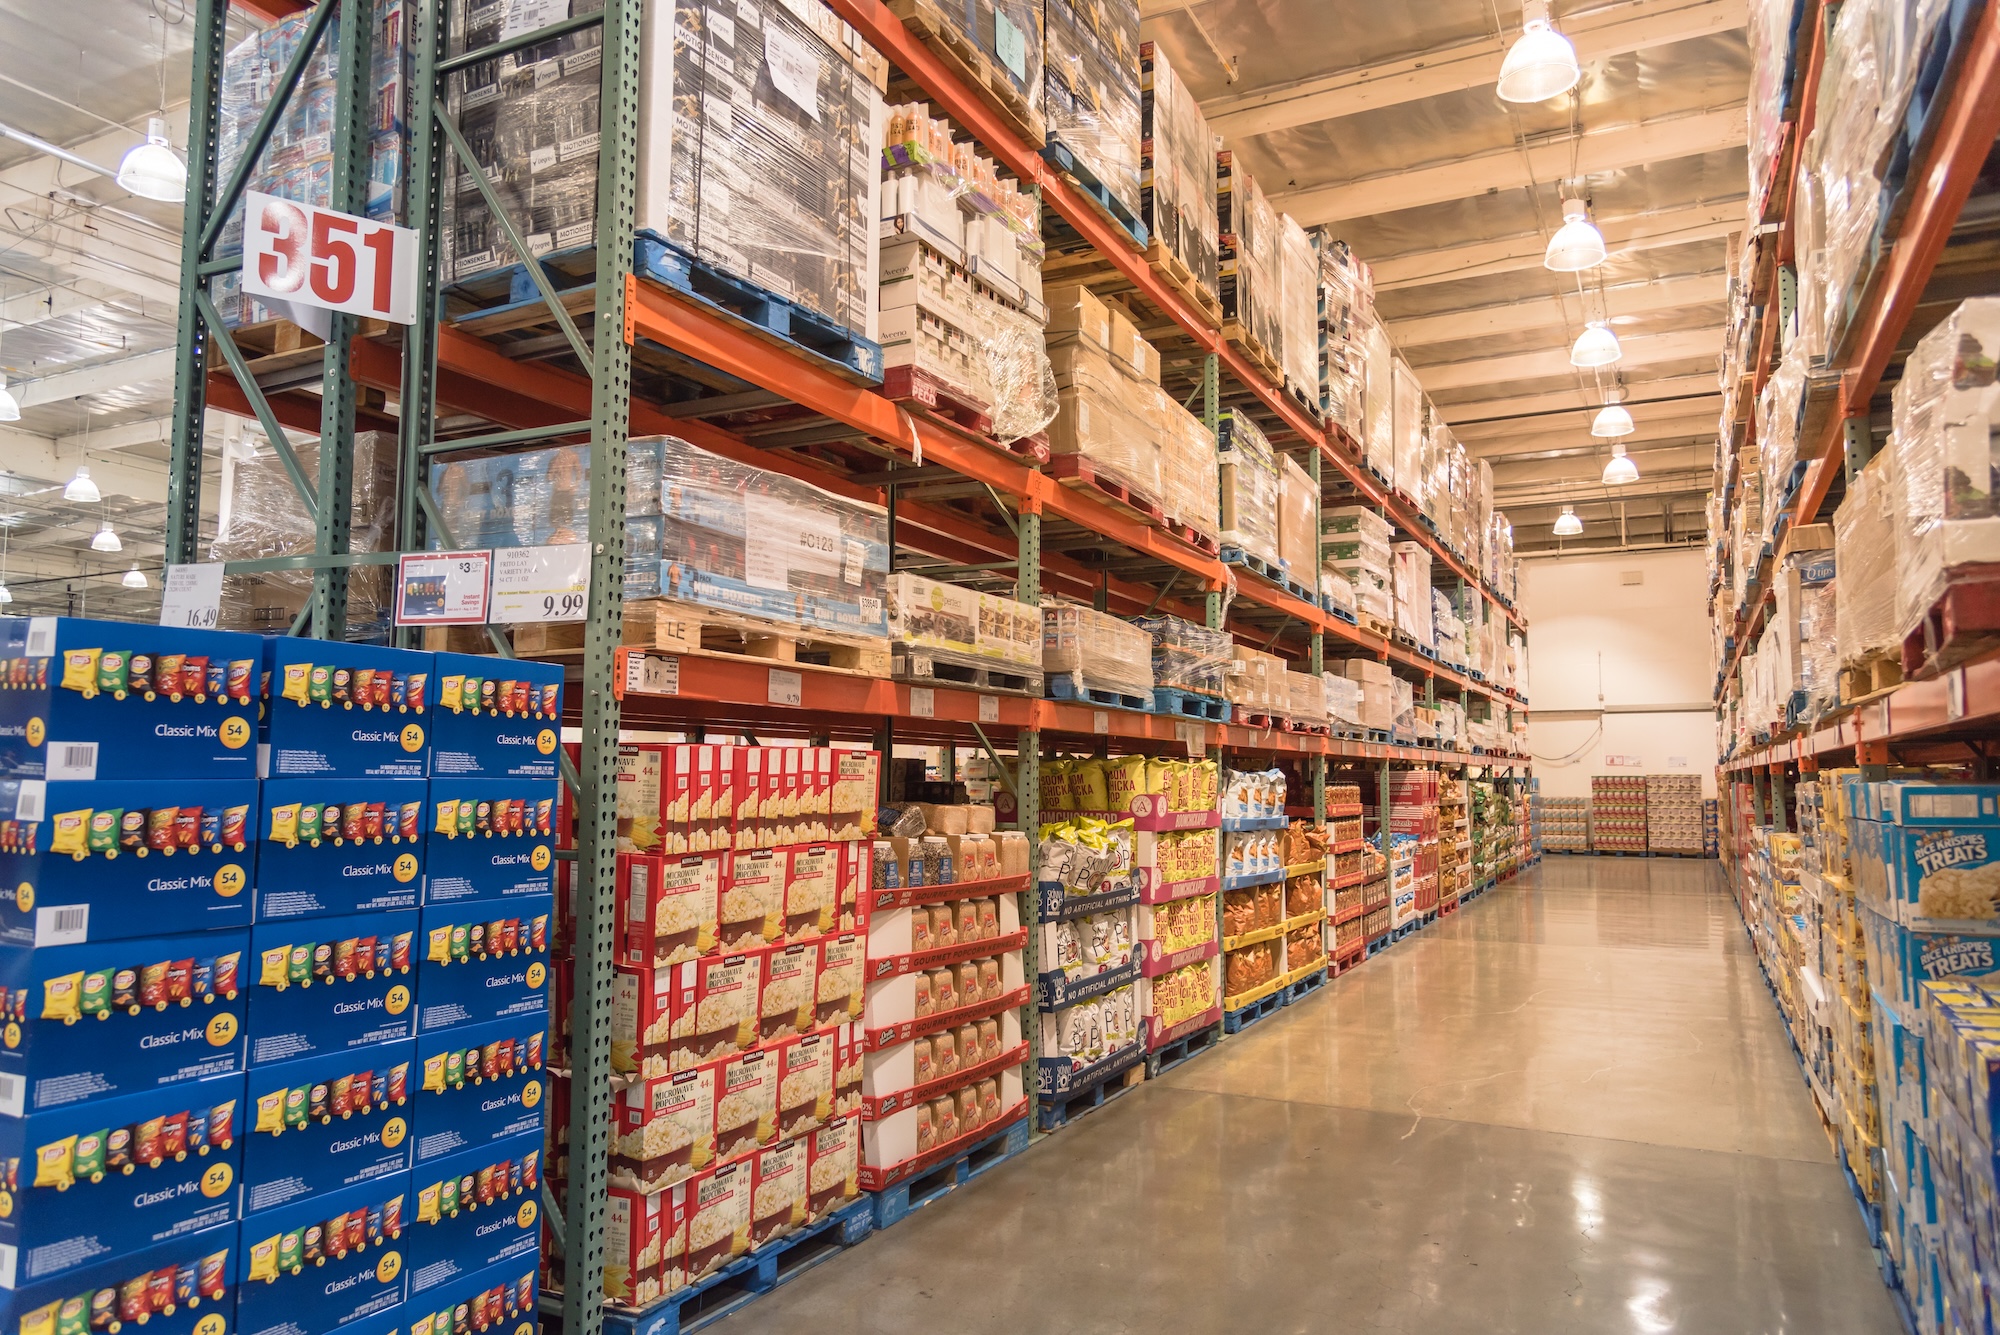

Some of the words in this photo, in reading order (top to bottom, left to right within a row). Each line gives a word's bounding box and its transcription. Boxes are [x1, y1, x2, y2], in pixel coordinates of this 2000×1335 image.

[712, 16, 729, 35] Degree
[678, 29, 728, 66] MOTIOSENSE
[567, 48, 601, 66] MOTIONSEN
[541, 69, 558, 81] Degree
[534, 240, 550, 250] Degree
[258, 200, 394, 313] 351
[883, 263, 909, 277] Aveeno
[880, 329, 907, 340] Aveeno
[800, 532, 834, 553] #C123
[506, 550, 530, 559] 910362
[459, 562, 471, 573] $3
[699, 574, 712, 583] PACK
[694, 581, 721, 598] KNIT
[722, 586, 763, 608] BOXERS
[543, 594, 584, 617] 9.99
[186, 608, 217, 627] 16.49
[814, 607, 834, 621] KNIT
[667, 621, 686, 640] LE
[183, 664, 201, 672] Doritos
[786, 694, 800, 703] 9.79
[155, 724, 194, 737] Classic
[196, 726, 217, 737] Mix
[227, 724, 243, 736] 54
[497, 735, 521, 745] Classic
[523, 736, 536, 745] Mix
[541, 735, 552, 745] 54
[176, 815, 195, 824] Doritos
[1914, 842, 1935, 859] RICE
[1936, 834, 1985, 850] KRISPIES
[491, 855, 516, 866] Classic
[517, 854, 530, 864] Mix
[535, 852, 546, 862] 54
[681, 856, 702, 865] KIRKLAND
[752, 851, 773, 859] KIRKLAND
[1917, 845, 1988, 878] TREATS
[342, 865, 374, 877] Classic
[375, 864, 392, 875] Mix
[399, 862, 412, 872] 54
[736, 861, 769, 871] MICROWAVE
[774, 860, 783, 869] 44
[221, 872, 238, 884] 54
[666, 868, 700, 880] MICROWAVE
[705, 873, 713, 883] 44
[736, 869, 762, 879] POPCORN
[147, 878, 188, 891] Classic
[190, 876, 212, 888] Mix
[666, 877, 693, 889] POPCORN
[915, 889, 952, 900] GOURMET
[955, 885, 988, 896] POPCORN
[1046, 898, 1063, 911] POP
[1064, 906, 1073, 915] NO
[1074, 899, 1103, 914] ARTIFICIAL
[1105, 893, 1131, 907] ANYTHING
[913, 953, 951, 966] GOURMET
[953, 947, 985, 958] POPCORN
[988, 941, 1016, 952] KERNELS
[1921, 949, 1942, 965] RICE
[1942, 941, 1992, 958] KRISPIES
[725, 956, 745, 964] KIRKLAND
[899, 957, 910, 965] NON
[709, 967, 742, 980] MICROWAVE
[899, 964, 909, 972] GMO
[1923, 953, 1994, 981] TREATS
[709, 977, 735, 988] POPCORN
[746, 971, 755, 981] 44
[1068, 991, 1077, 1001] NO
[1077, 980, 1106, 998] ARTIFICIAL
[1107, 970, 1132, 985] ANYTHING
[391, 993, 404, 1003] 54
[334, 1002, 365, 1015] Classic
[366, 999, 384, 1010] Mix
[915, 1016, 952, 1033] GOURMET
[954, 1006, 986, 1021] POPCORN
[213, 1021, 230, 1033] 54
[902, 1023, 912, 1031] NON
[140, 1032, 181, 1049] Classic
[182, 1028, 204, 1042] Mix
[900, 1031, 911, 1040] GMO
[743, 1052, 764, 1062] KIRKLAND
[765, 1059, 775, 1068] 44
[728, 1063, 761, 1079] MICROWAVE
[1056, 1063, 1072, 1076] SKINNY
[1072, 1080, 1081, 1089] NO
[1082, 1063, 1111, 1086] ARTIFICIAL
[1113, 1049, 1138, 1068] ANYTHING
[673, 1071, 697, 1082] KIRKLAND
[728, 1073, 754, 1087] POPCORN
[1057, 1074, 1073, 1088] POP
[700, 1079, 709, 1089] 44
[655, 1083, 694, 1101] MICROWAVE
[655, 1094, 686, 1110] POPCORN
[388, 1125, 401, 1136] 54
[330, 1139, 361, 1154] Classic
[362, 1134, 380, 1146] Mix
[715, 1164, 737, 1178] KIRKLAND
[209, 1171, 225, 1185] 54
[700, 1175, 734, 1193] MICROWAVE
[738, 1177, 747, 1187] 44
[134, 1187, 175, 1208] Classic
[177, 1181, 199, 1196] Mix
[700, 1186, 727, 1203] POPCORN
[383, 1260, 396, 1271] 54
[325, 1279, 357, 1295] Classic
[358, 1271, 376, 1285] Mix
